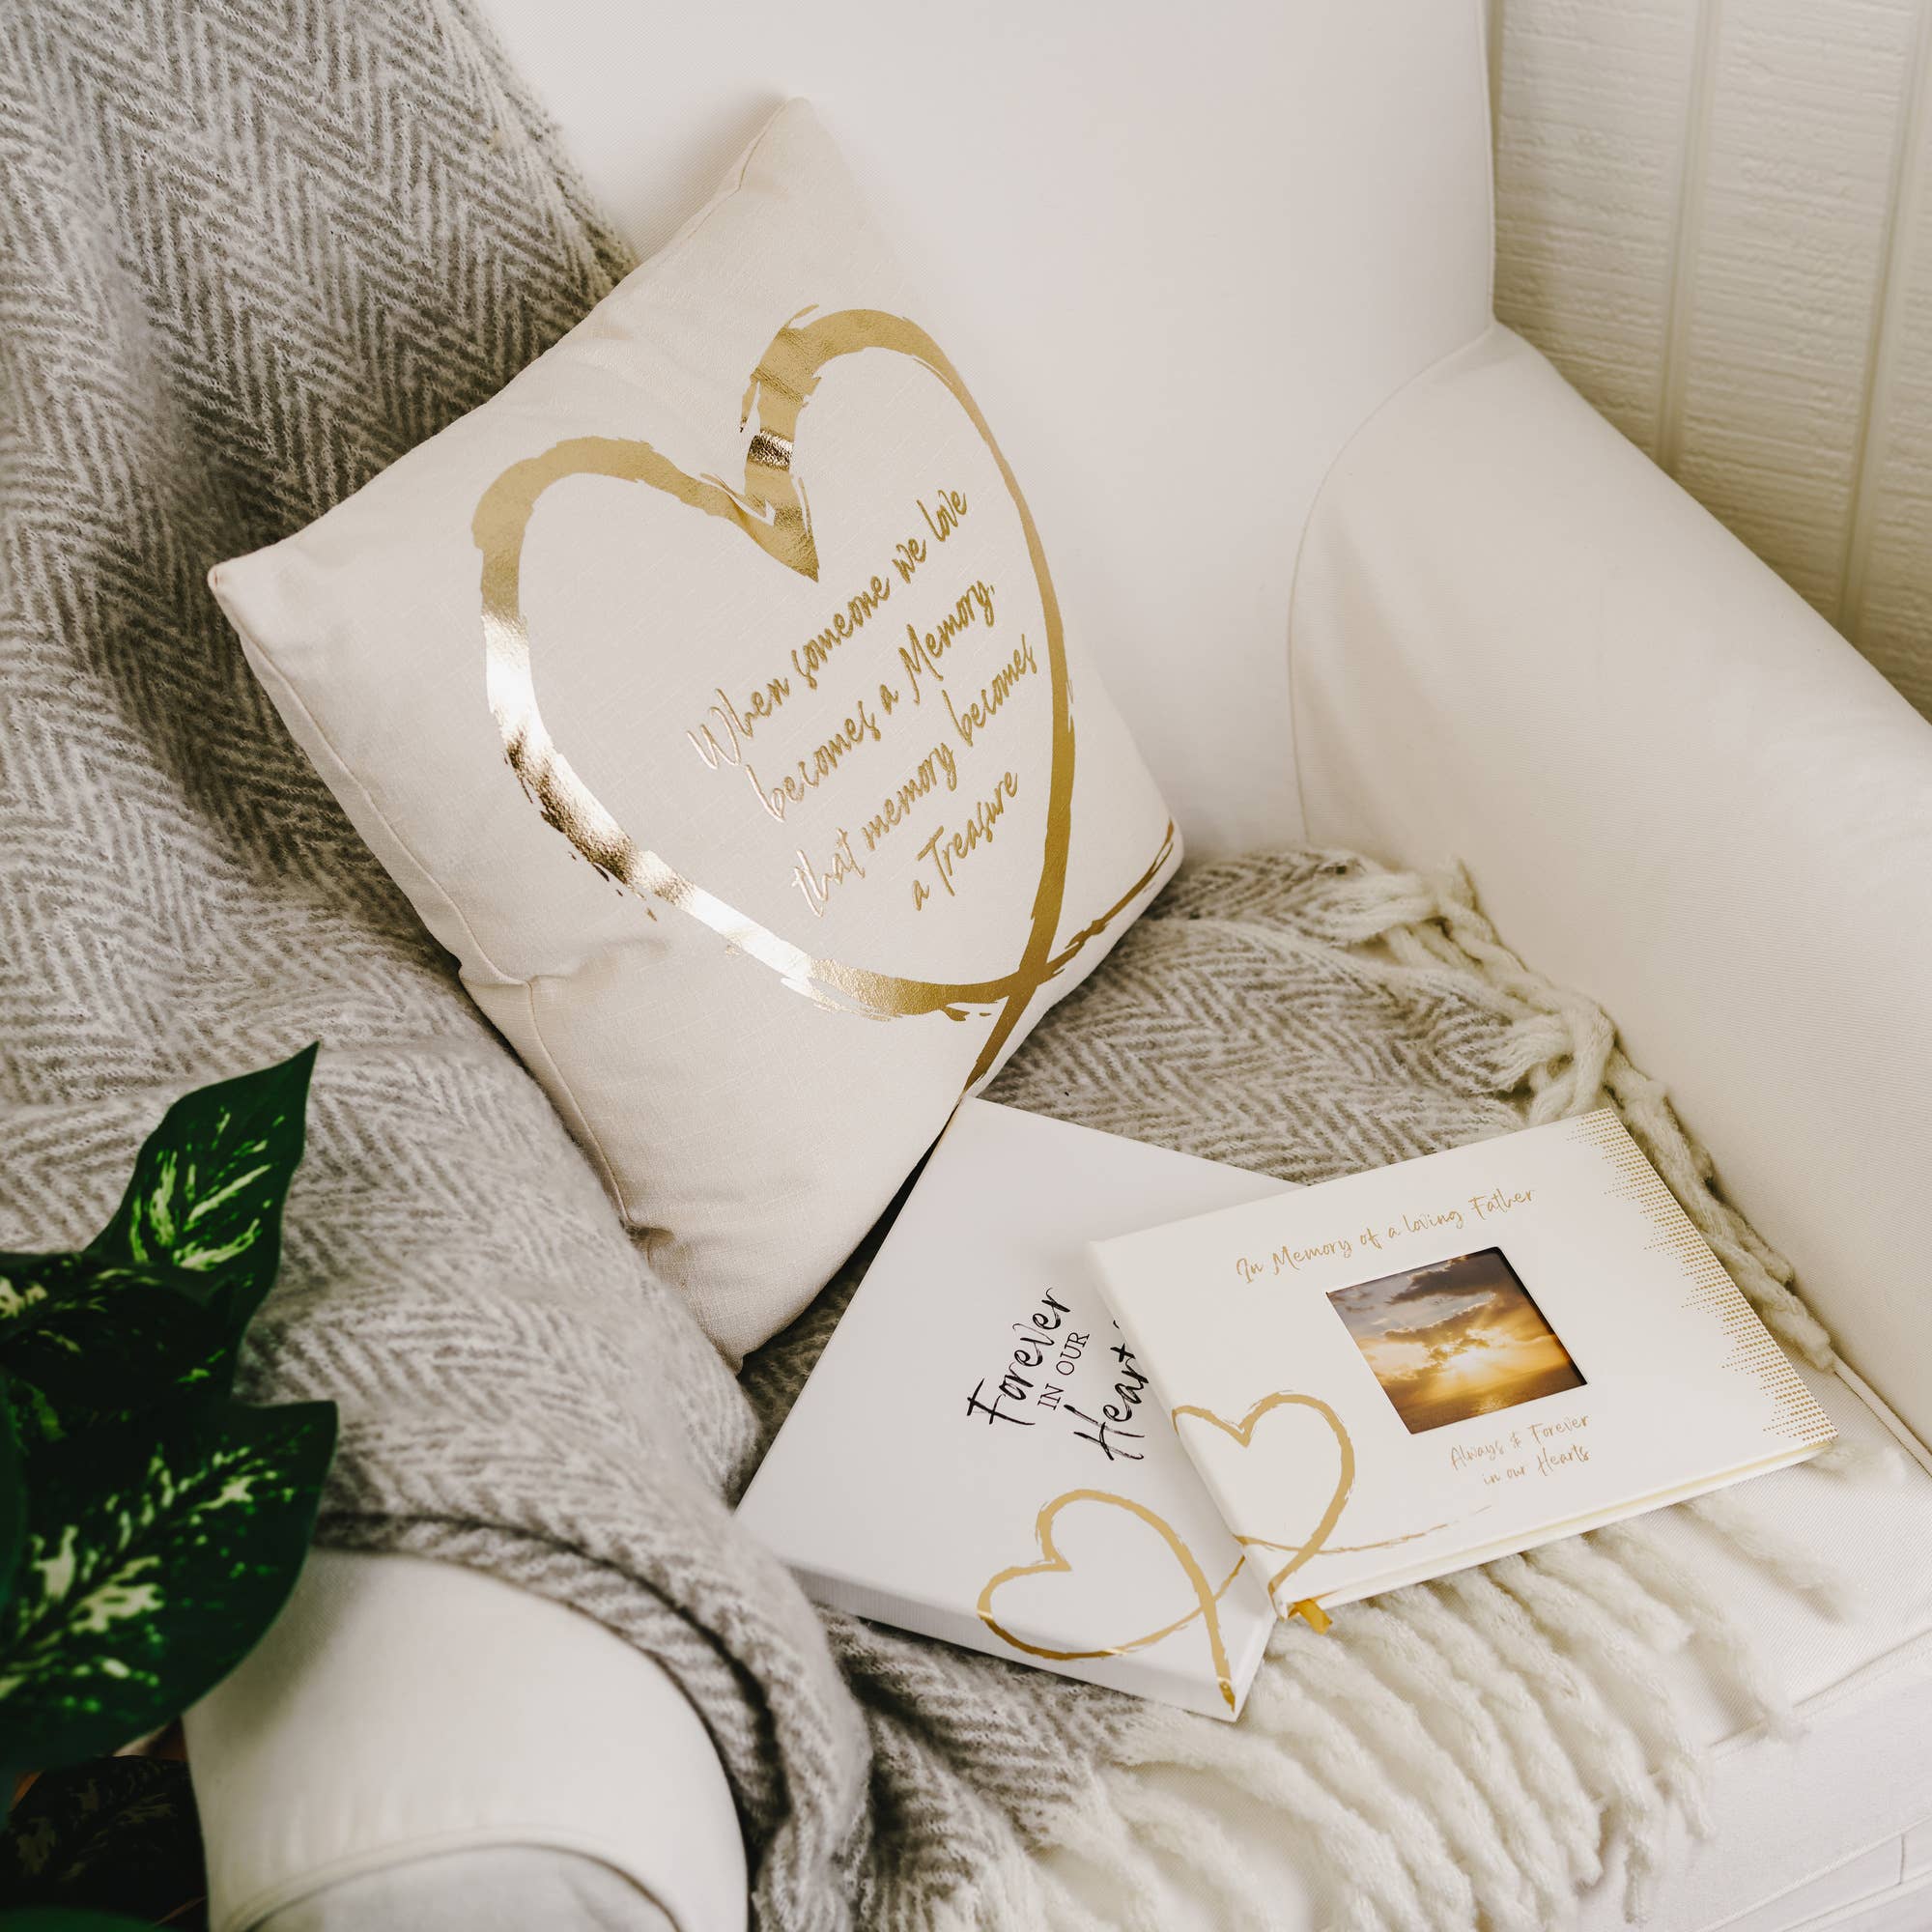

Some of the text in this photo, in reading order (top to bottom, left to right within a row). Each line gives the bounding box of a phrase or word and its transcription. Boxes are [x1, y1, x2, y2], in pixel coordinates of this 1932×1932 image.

[686, 489, 968, 770] When someone we love
[746, 700, 882, 823] becomes
[880, 683, 899, 715] a
[791, 634, 1037, 918] that memory becomes
[912, 771, 1018, 911] a Treasure
[1236, 1187, 1536, 1284] In Memory of a loving Father
[967, 1287, 1071, 1426] Forever
[1037, 1332, 1091, 1410] IN OUR
[1064, 1320, 1150, 1461] Heart
[1451, 1441, 1504, 1471] Always
[1527, 1413, 1589, 1445] Forever
[1482, 1444, 1591, 1485] in our Hearts
